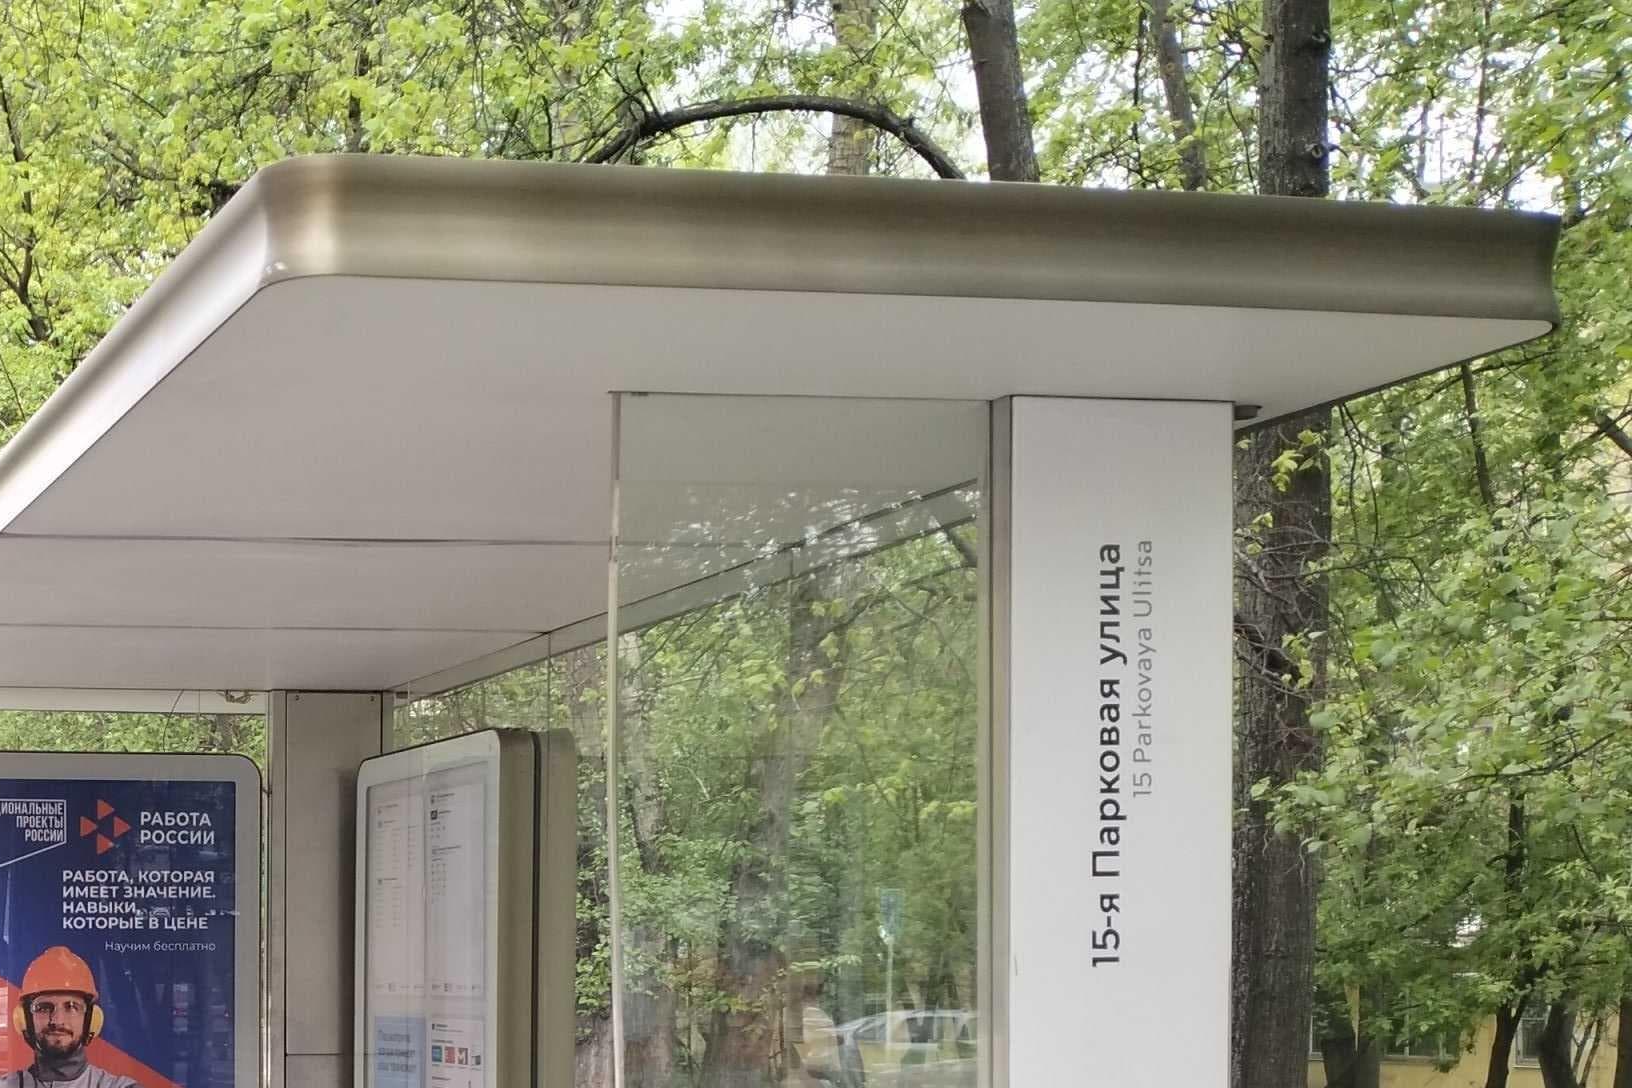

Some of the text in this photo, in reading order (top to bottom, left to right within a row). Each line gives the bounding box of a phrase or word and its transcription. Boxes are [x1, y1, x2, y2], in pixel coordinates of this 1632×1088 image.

[1132, 539, 1158, 799] 15 Parkovaya Ulitsa
[1091, 543, 1128, 968] 15-я Парковая улица
[16, 816, 64, 829] ПРОЕКТЫ
[140, 811, 212, 827] РАБОТА
[24, 829, 64, 842] РОССИИ
[140, 830, 216, 845] РОССИИ
[62, 870, 215, 884] РАБОТА, КОТОРАЯ
[62, 886, 216, 899] ИМЕЕТ ЗНАЧЕНИЕ.
[62, 901, 141, 916] НАВЫКИ,
[62, 916, 209, 932] КОТОРЫЕ В ЦЕНЕ
[105, 940, 216, 953] Научим бесплатно
